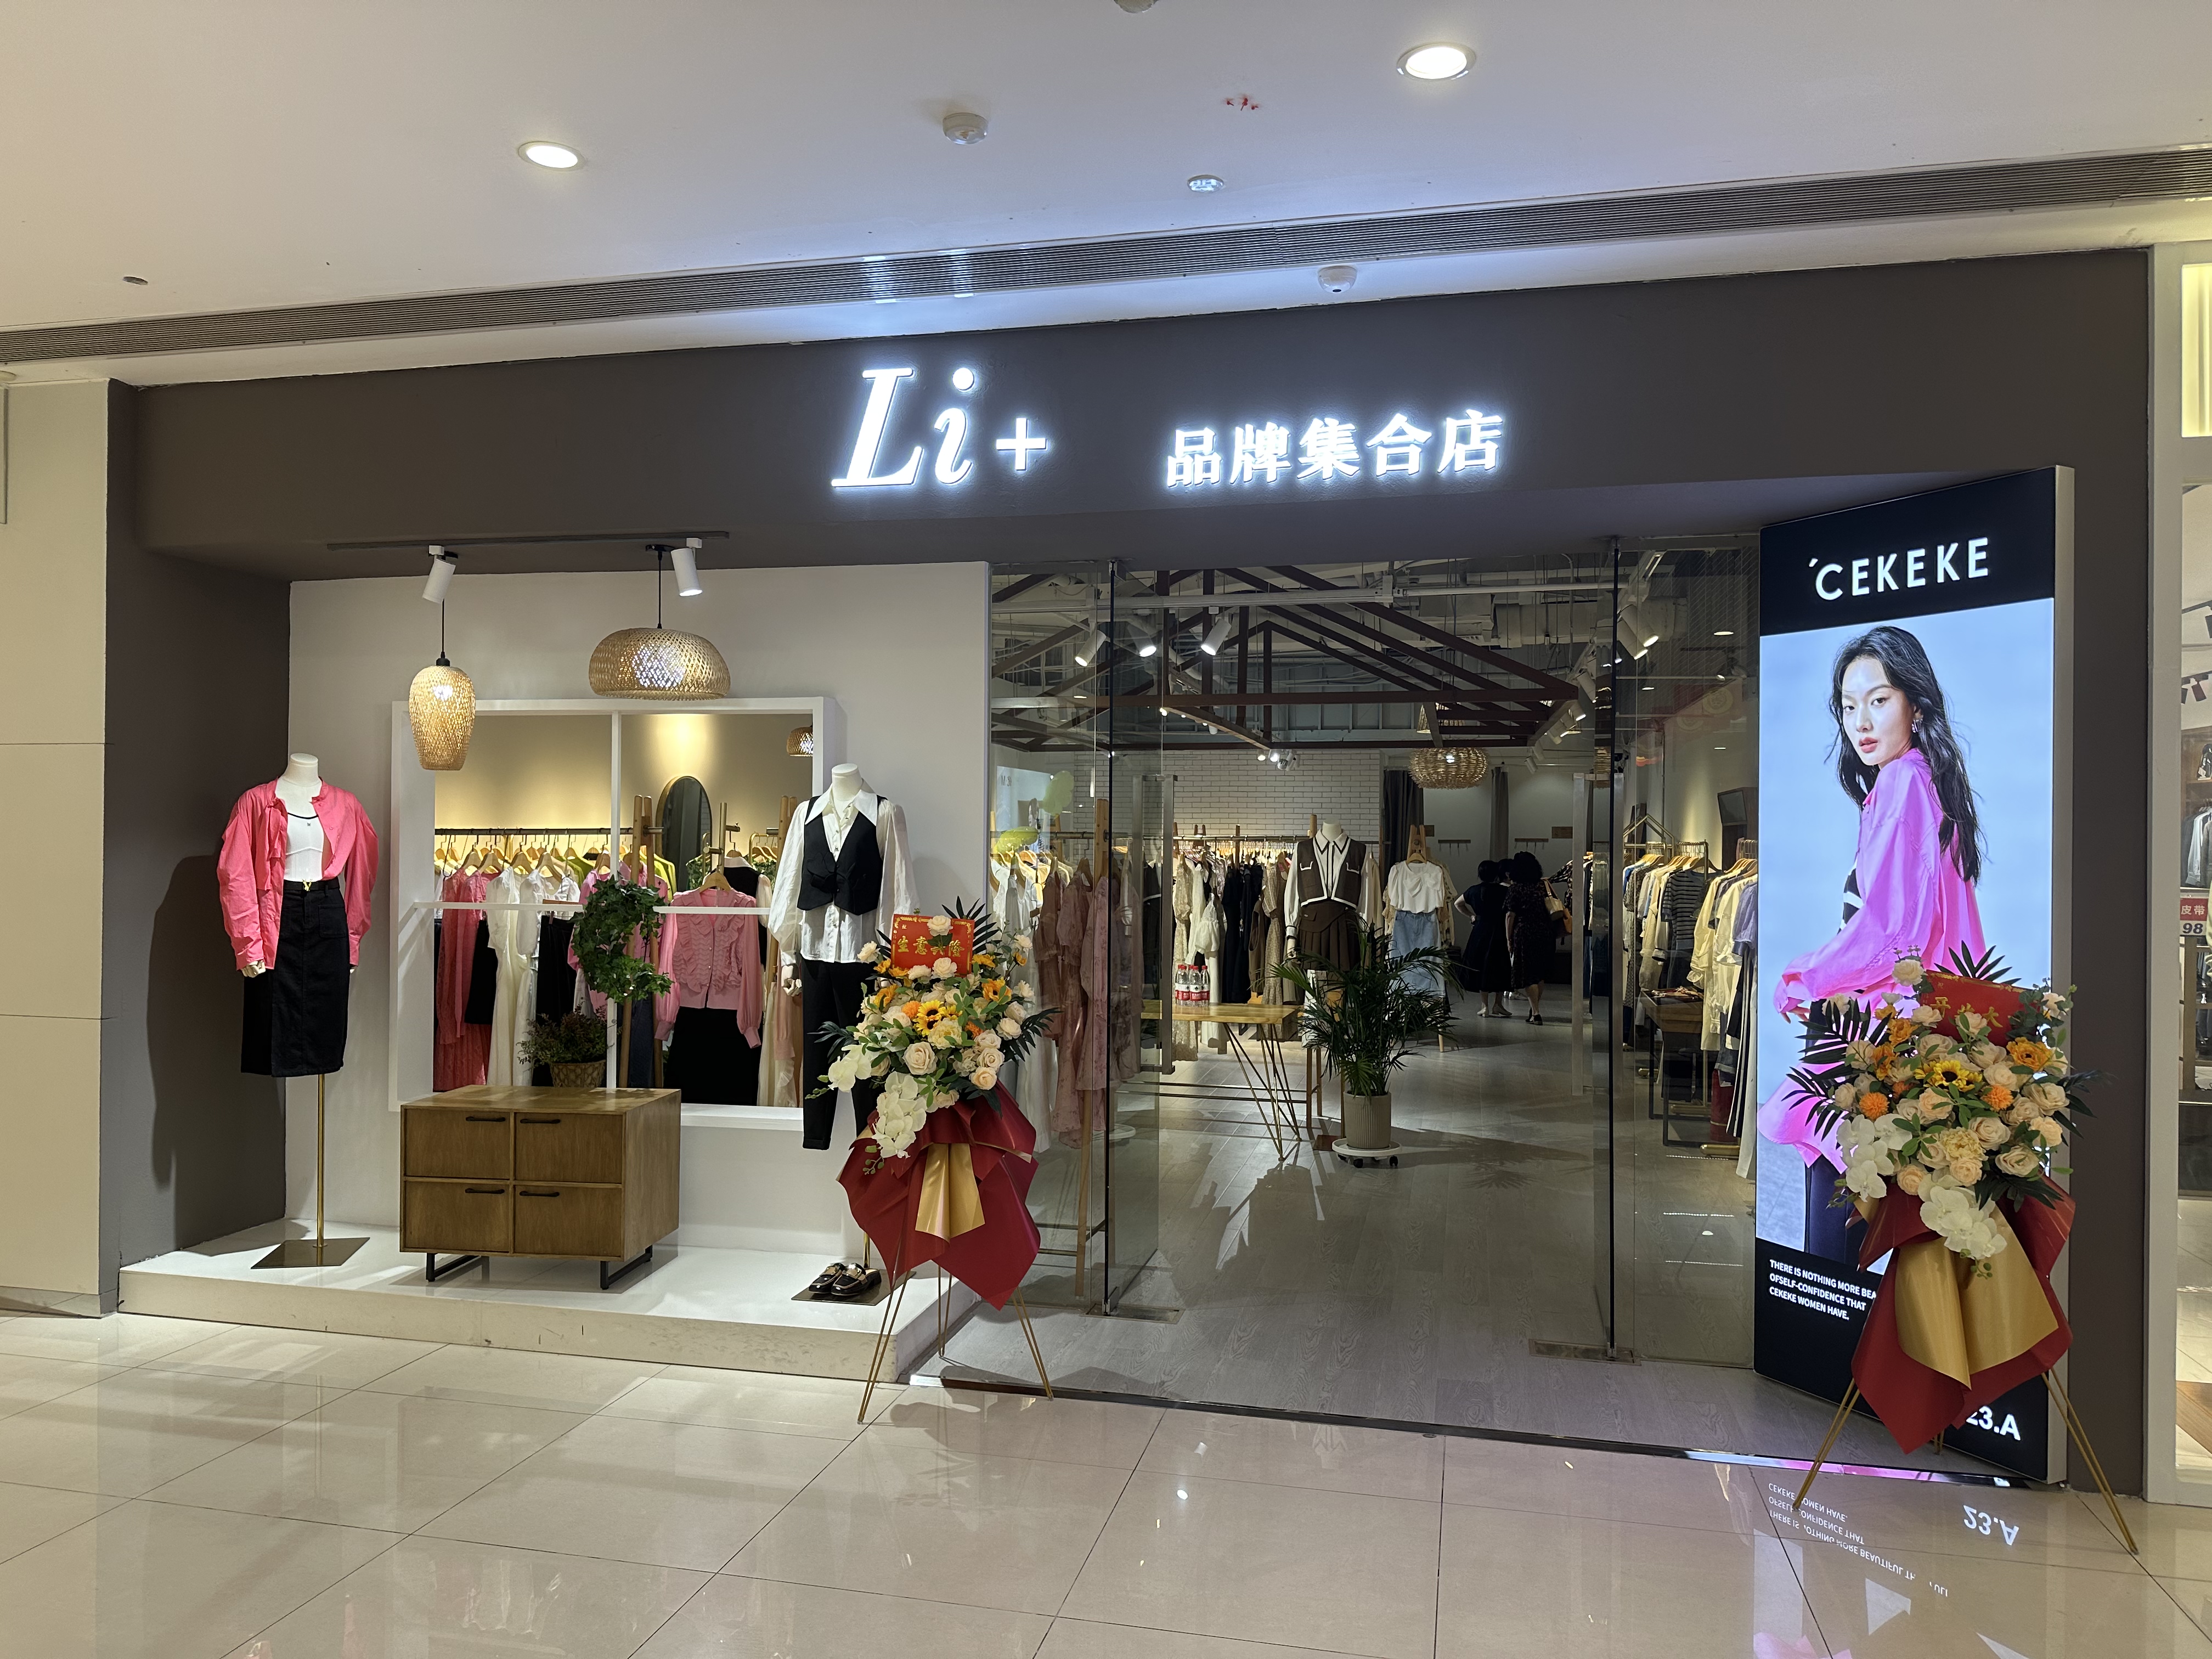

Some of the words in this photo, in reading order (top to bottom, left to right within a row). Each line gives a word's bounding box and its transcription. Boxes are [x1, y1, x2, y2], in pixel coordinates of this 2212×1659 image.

[1166, 408, 1504, 489] 品牌集合店
[2182, 923, 2203, 934] 98
[1769, 1273, 1845, 1305] OFSELF-CONFIDENCE
[1846, 1297, 1866, 1311] THAT
[1770, 1259, 1793, 1274] THERE
[1794, 1267, 1801, 1277] IS
[1802, 1269, 1837, 1288] NOTHING
[1838, 1280, 1860, 1295] MORE
[1769, 1286, 1797, 1302] CEKEKE
[1798, 1295, 1826, 1312] WOMEN
